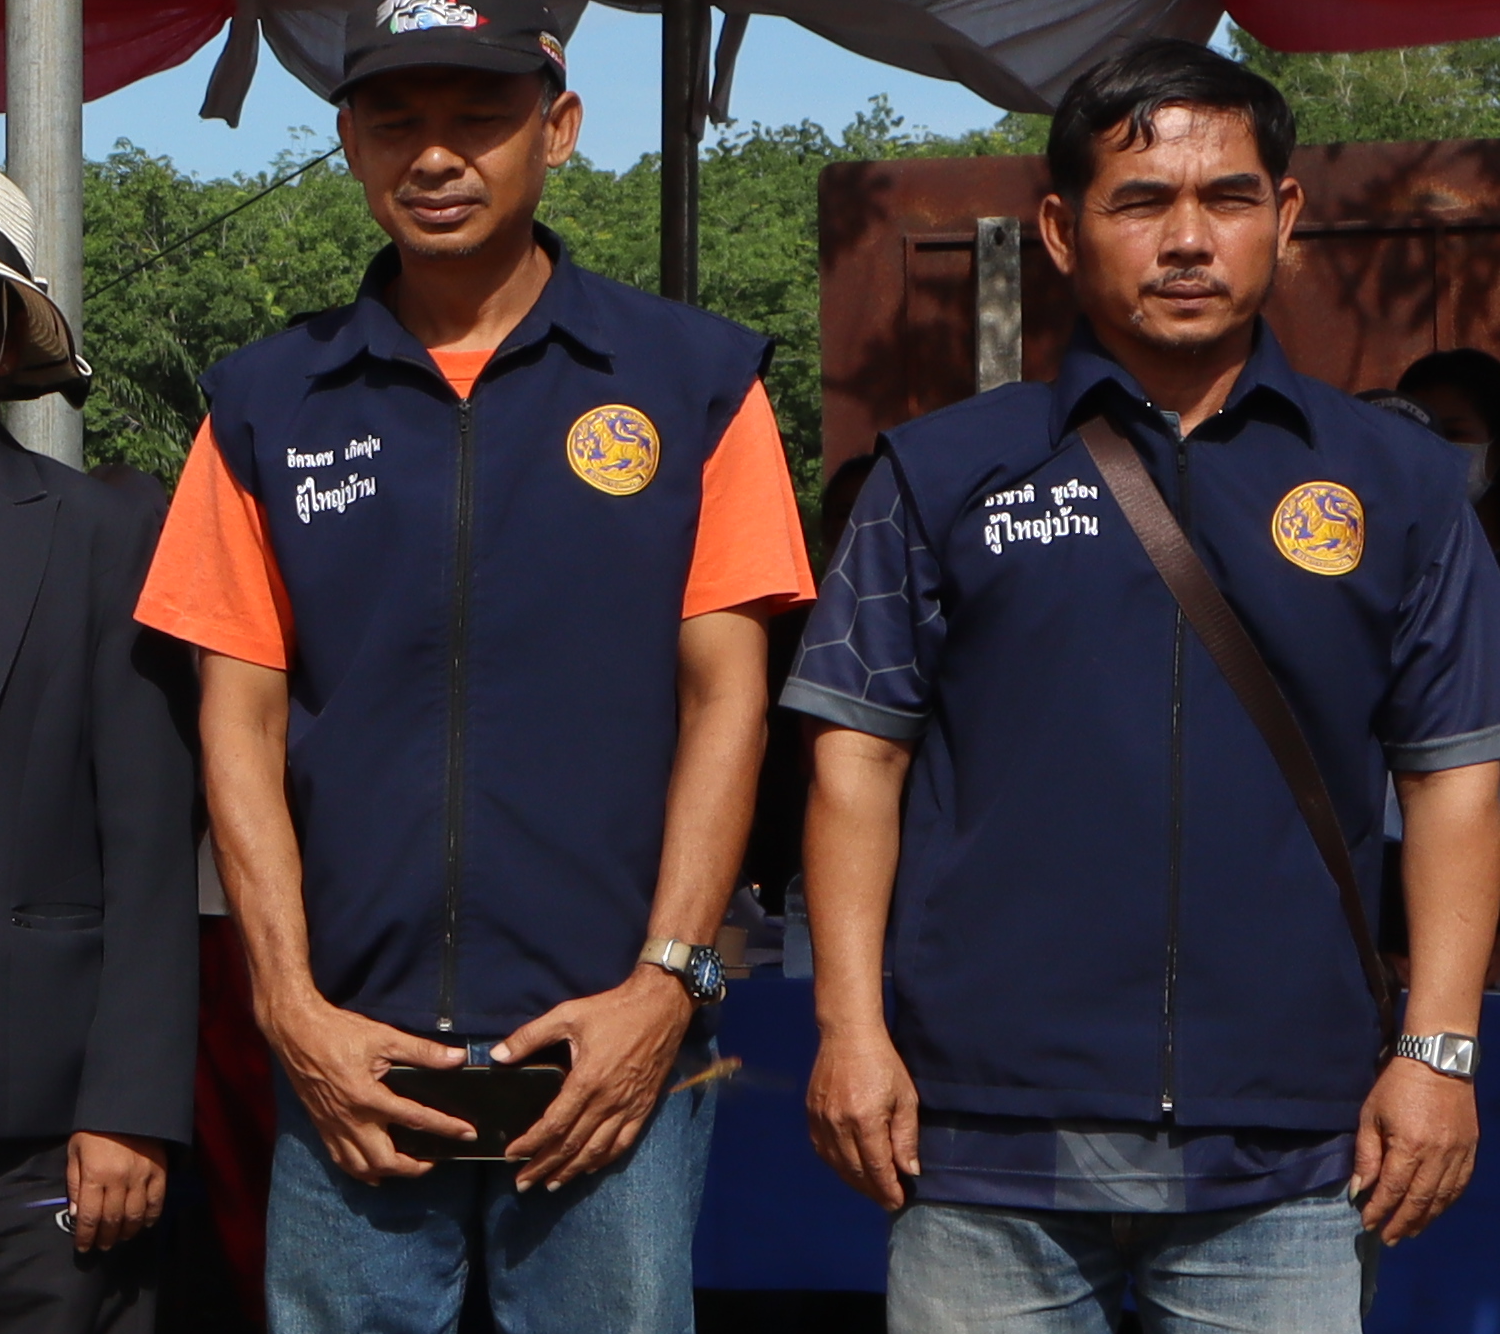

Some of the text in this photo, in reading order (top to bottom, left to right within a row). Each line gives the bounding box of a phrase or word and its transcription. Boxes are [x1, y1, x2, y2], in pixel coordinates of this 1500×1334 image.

[296, 472, 377, 524] ผู้ใหญ่บ้าน
[984, 506, 1099, 555] ผู้ใหญ่บ้าน
